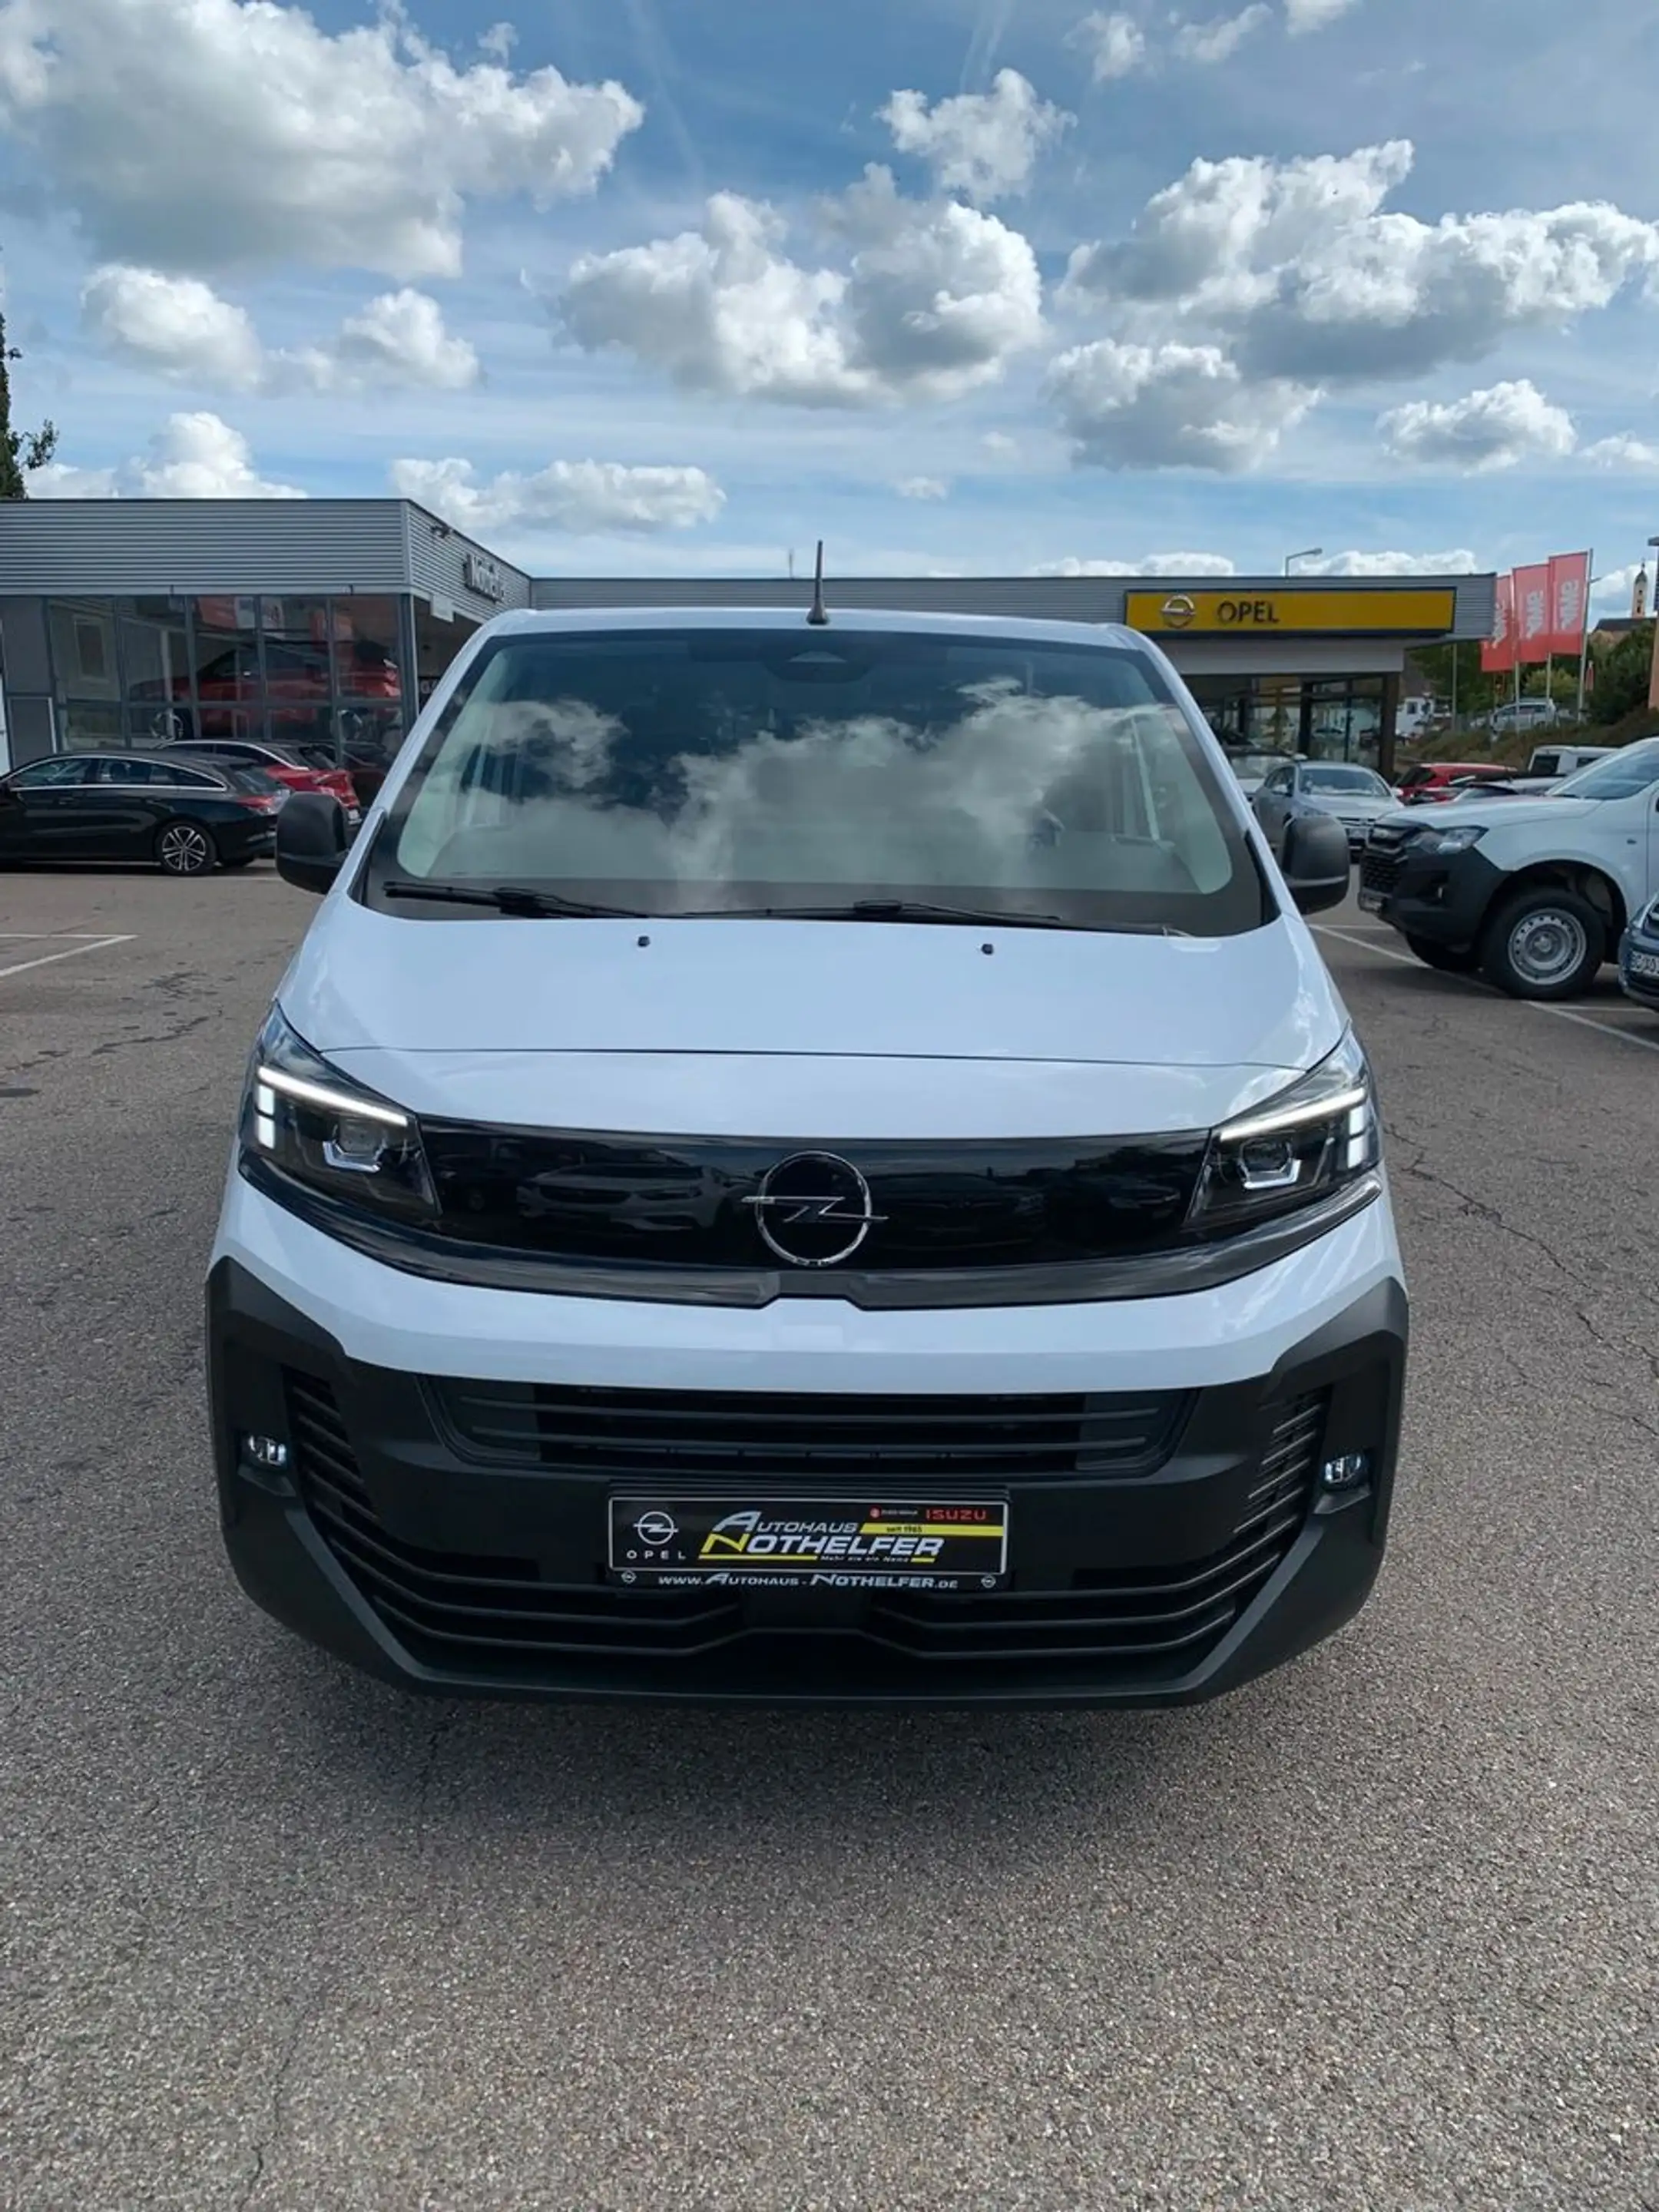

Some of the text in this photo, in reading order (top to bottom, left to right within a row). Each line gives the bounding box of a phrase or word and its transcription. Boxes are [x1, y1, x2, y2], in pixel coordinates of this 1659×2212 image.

[1217, 601, 1280, 624] OPEL
[926, 1509, 987, 1521] ISUZU
[700, 1533, 945, 1556] NOTHELFER
[626, 1550, 687, 1560] OPEL
